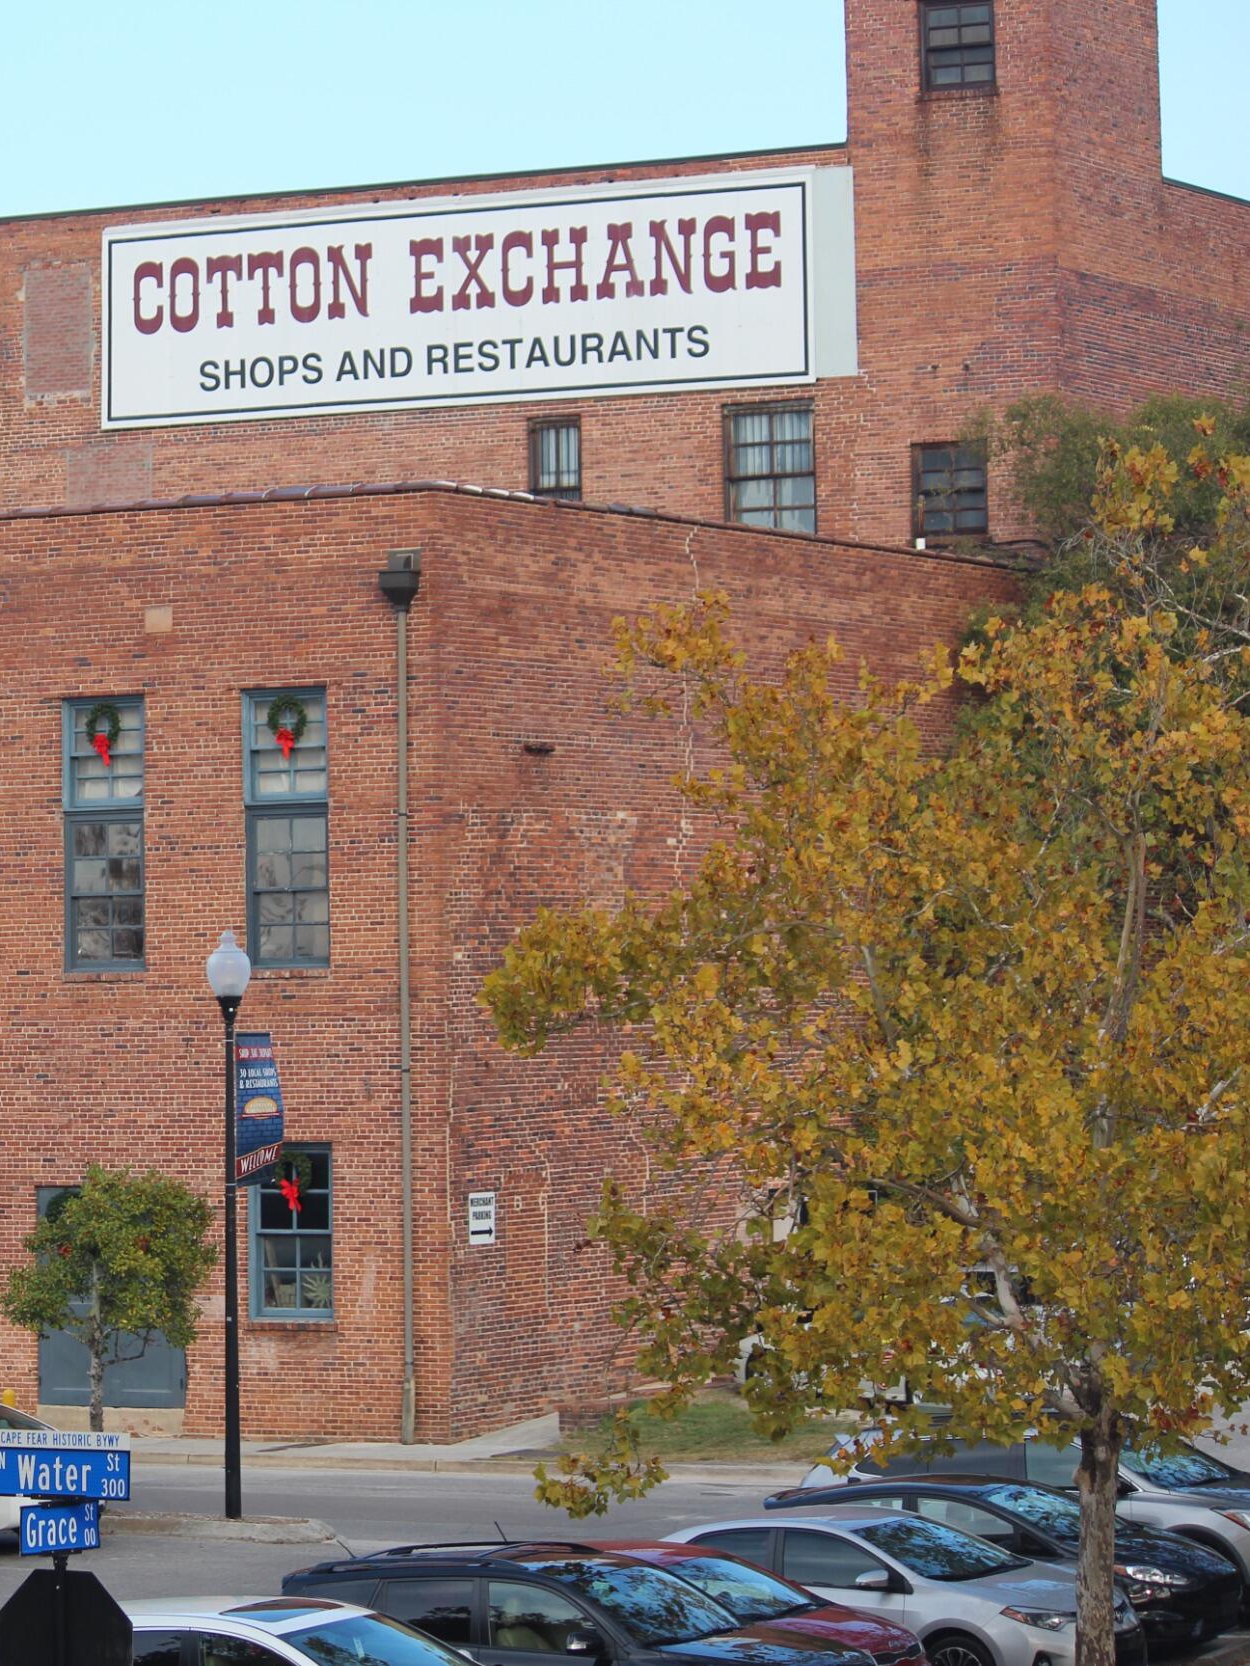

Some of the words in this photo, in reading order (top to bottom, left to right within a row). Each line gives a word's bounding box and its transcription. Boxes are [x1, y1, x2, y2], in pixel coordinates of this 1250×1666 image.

[132, 243, 373, 335] COTTON
[409, 210, 783, 314] EXCHANGE
[198, 352, 323, 392] SHOPS
[335, 346, 413, 382] AND
[426, 325, 710, 376] RESTAURANTS
[240, 1068, 247, 1078] 30
[248, 1068, 262, 1078] LOCAL
[262, 1068, 277, 1077] SHOPS
[240, 1080, 244, 1089] &
[245, 1079, 279, 1089] RESTAURANTS
[240, 1146, 278, 1174] WELCOME
[470, 1197, 494, 1207] MERCHANT
[472, 1211, 492, 1220] PARKING
[0, 1431, 22, 1444] CAPE
[26, 1432, 48, 1445] FEAR
[53, 1433, 92, 1446] HISTORIC
[96, 1435, 120, 1447] BYWY
[17, 1454, 92, 1492] Water
[107, 1453, 120, 1472] St
[101, 1479, 125, 1497] 300
[26, 1512, 77, 1548] Grace
[84, 1504, 94, 1521] St
[84, 1528, 96, 1546] 00
